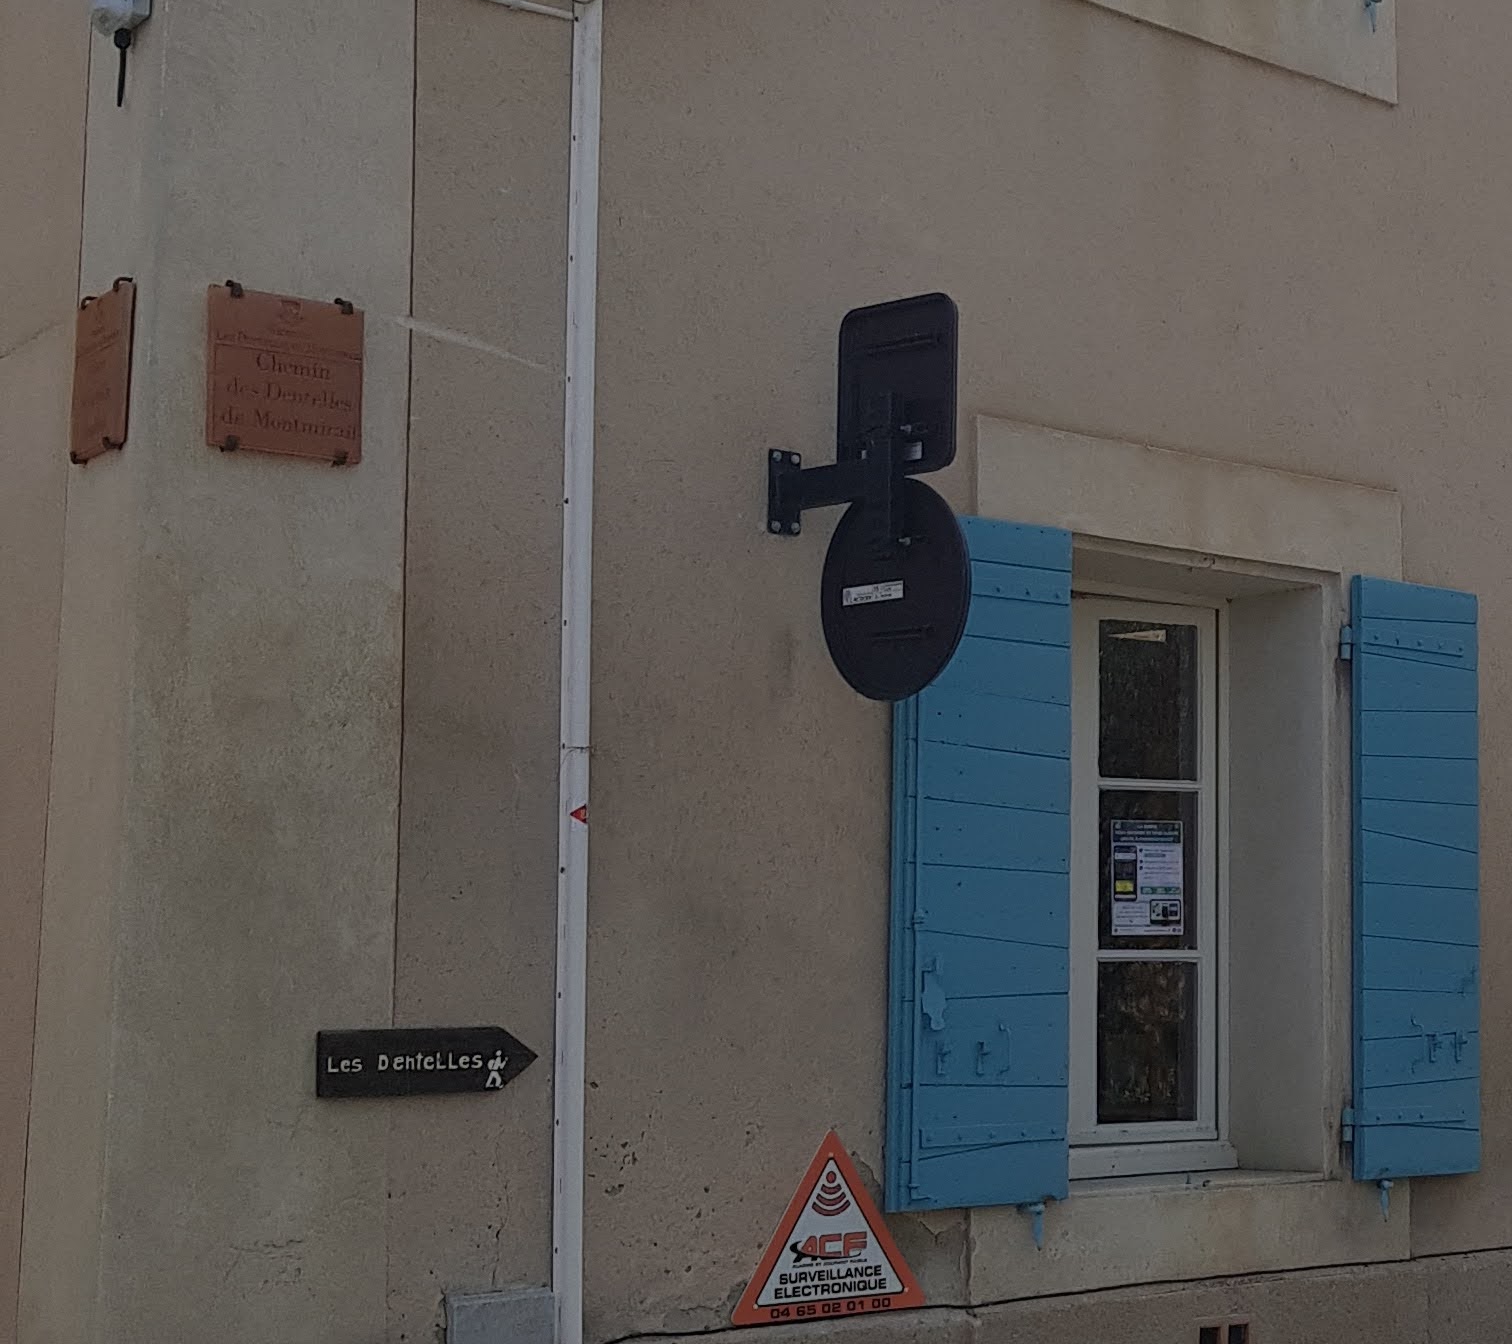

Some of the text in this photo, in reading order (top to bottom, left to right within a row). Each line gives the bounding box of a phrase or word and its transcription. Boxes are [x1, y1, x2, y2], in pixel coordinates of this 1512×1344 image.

[256, 353, 331, 380] Chemin
[265, 382, 352, 411] Dentelles
[254, 408, 357, 441] Montmirail
[327, 1056, 363, 1073] Les
[799, 1230, 868, 1258] ACF
[779, 1264, 882, 1285] SURVEILLANCE
[774, 1278, 887, 1299] ELECTRONIQUE
[770, 1297, 891, 1319] 04 65 02 01 00
